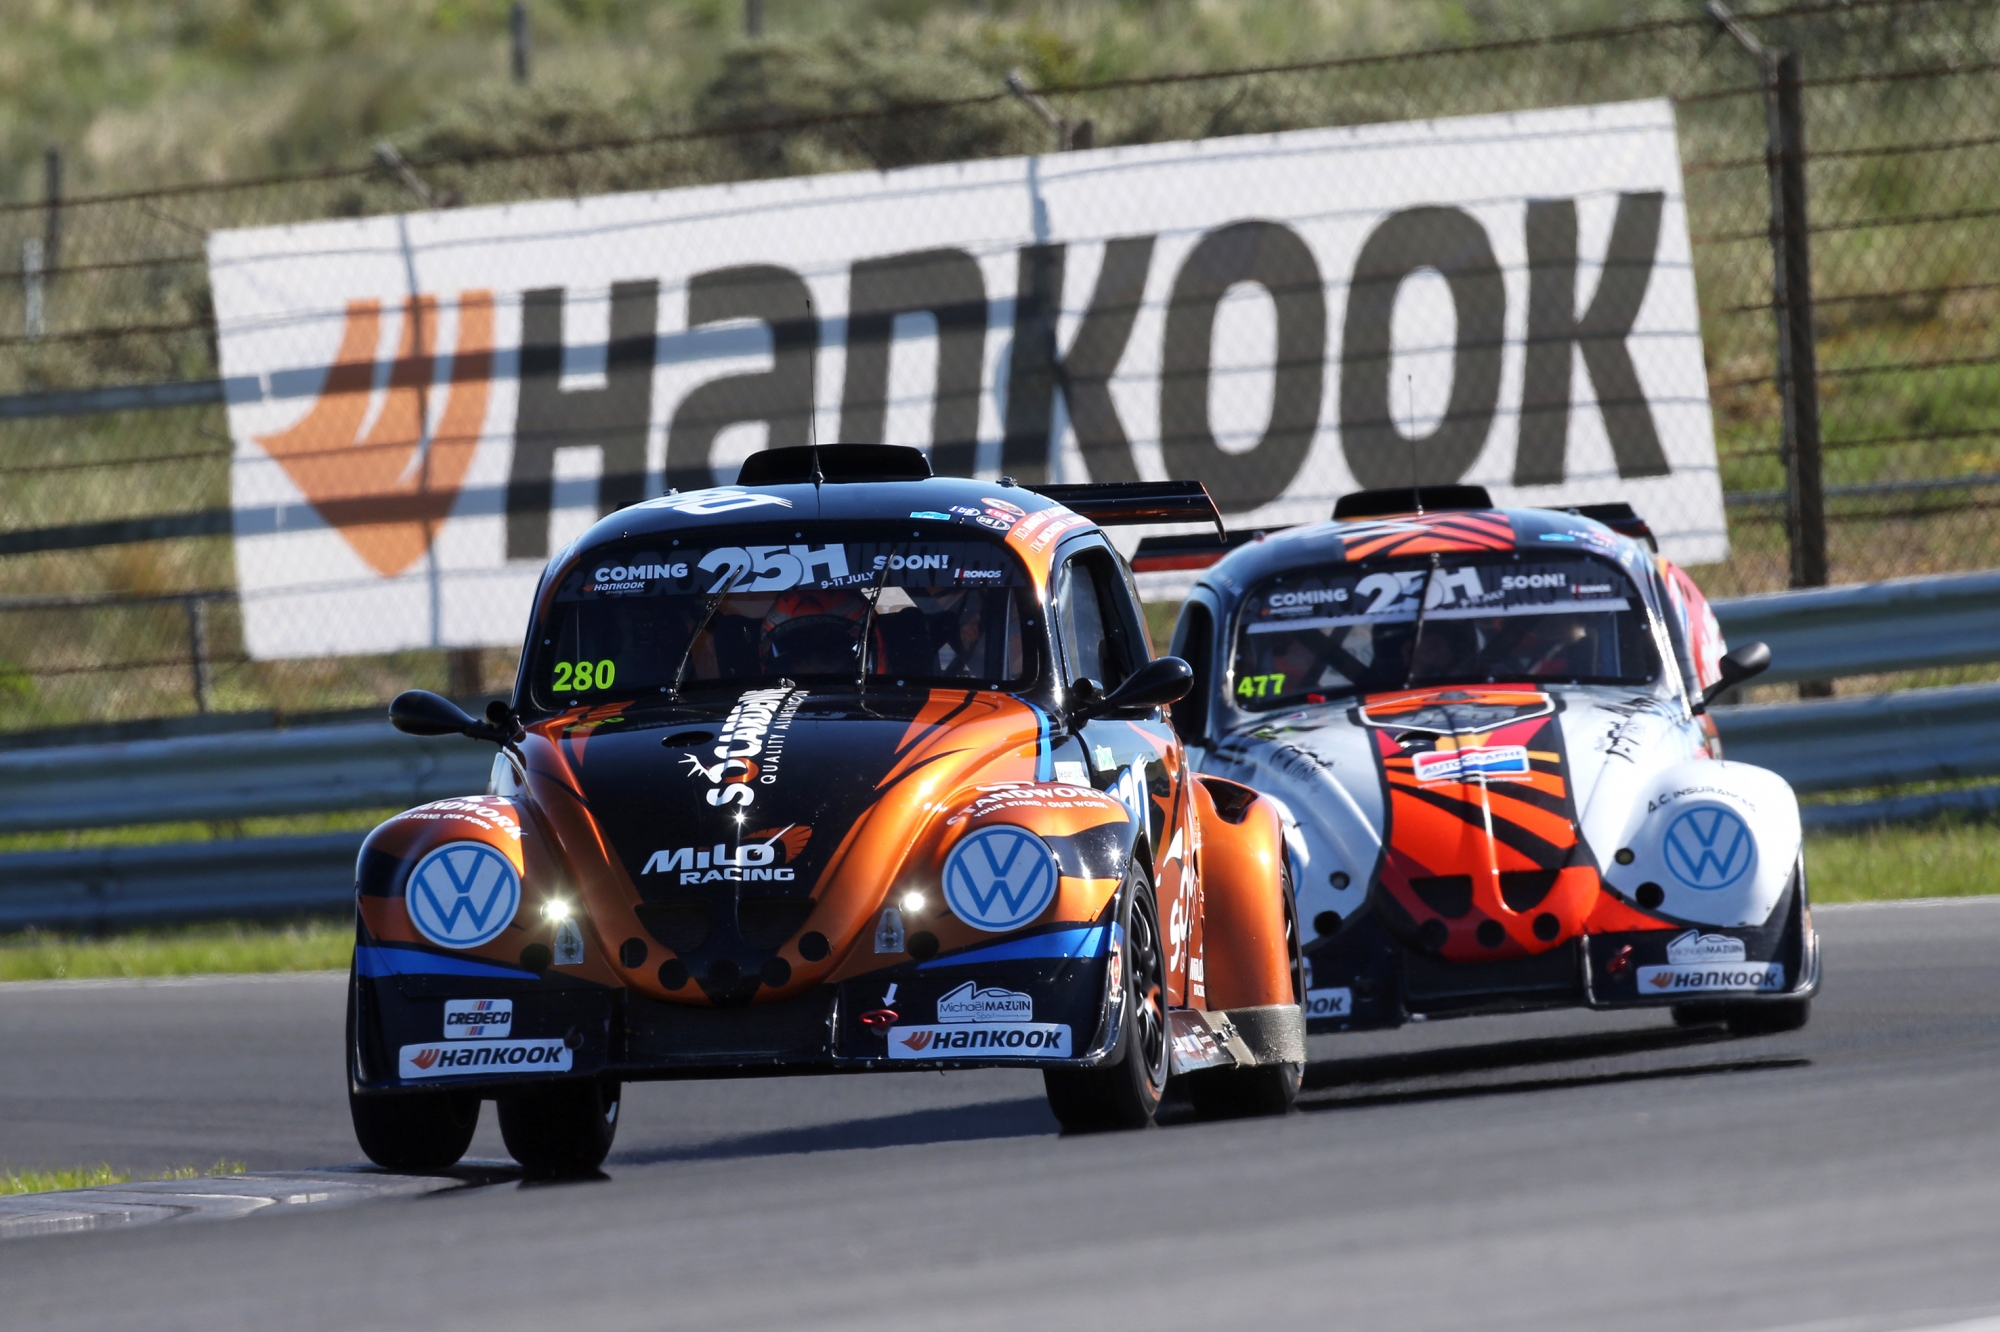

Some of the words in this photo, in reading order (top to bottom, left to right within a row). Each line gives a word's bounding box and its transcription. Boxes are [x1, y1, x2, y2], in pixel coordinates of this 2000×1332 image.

[595, 563, 688, 582] COMING
[698, 543, 849, 594] 25H
[873, 555, 949, 570] SOON!
[820, 578, 844, 589] 9-11
[846, 571, 875, 584] JULY
[1269, 587, 1349, 607] COMING
[1501, 573, 1567, 590] SOON!
[552, 660, 616, 691] 280
[1237, 673, 1286, 697] 477
[760, 734, 785, 785] QUALITY
[973, 804, 1005, 817] YOUR
[1047, 800, 1074, 809] OUR
[1074, 801, 1109, 809] WORK
[680, 868, 795, 885] RACING
[446, 1011, 511, 1025] CREDECO
